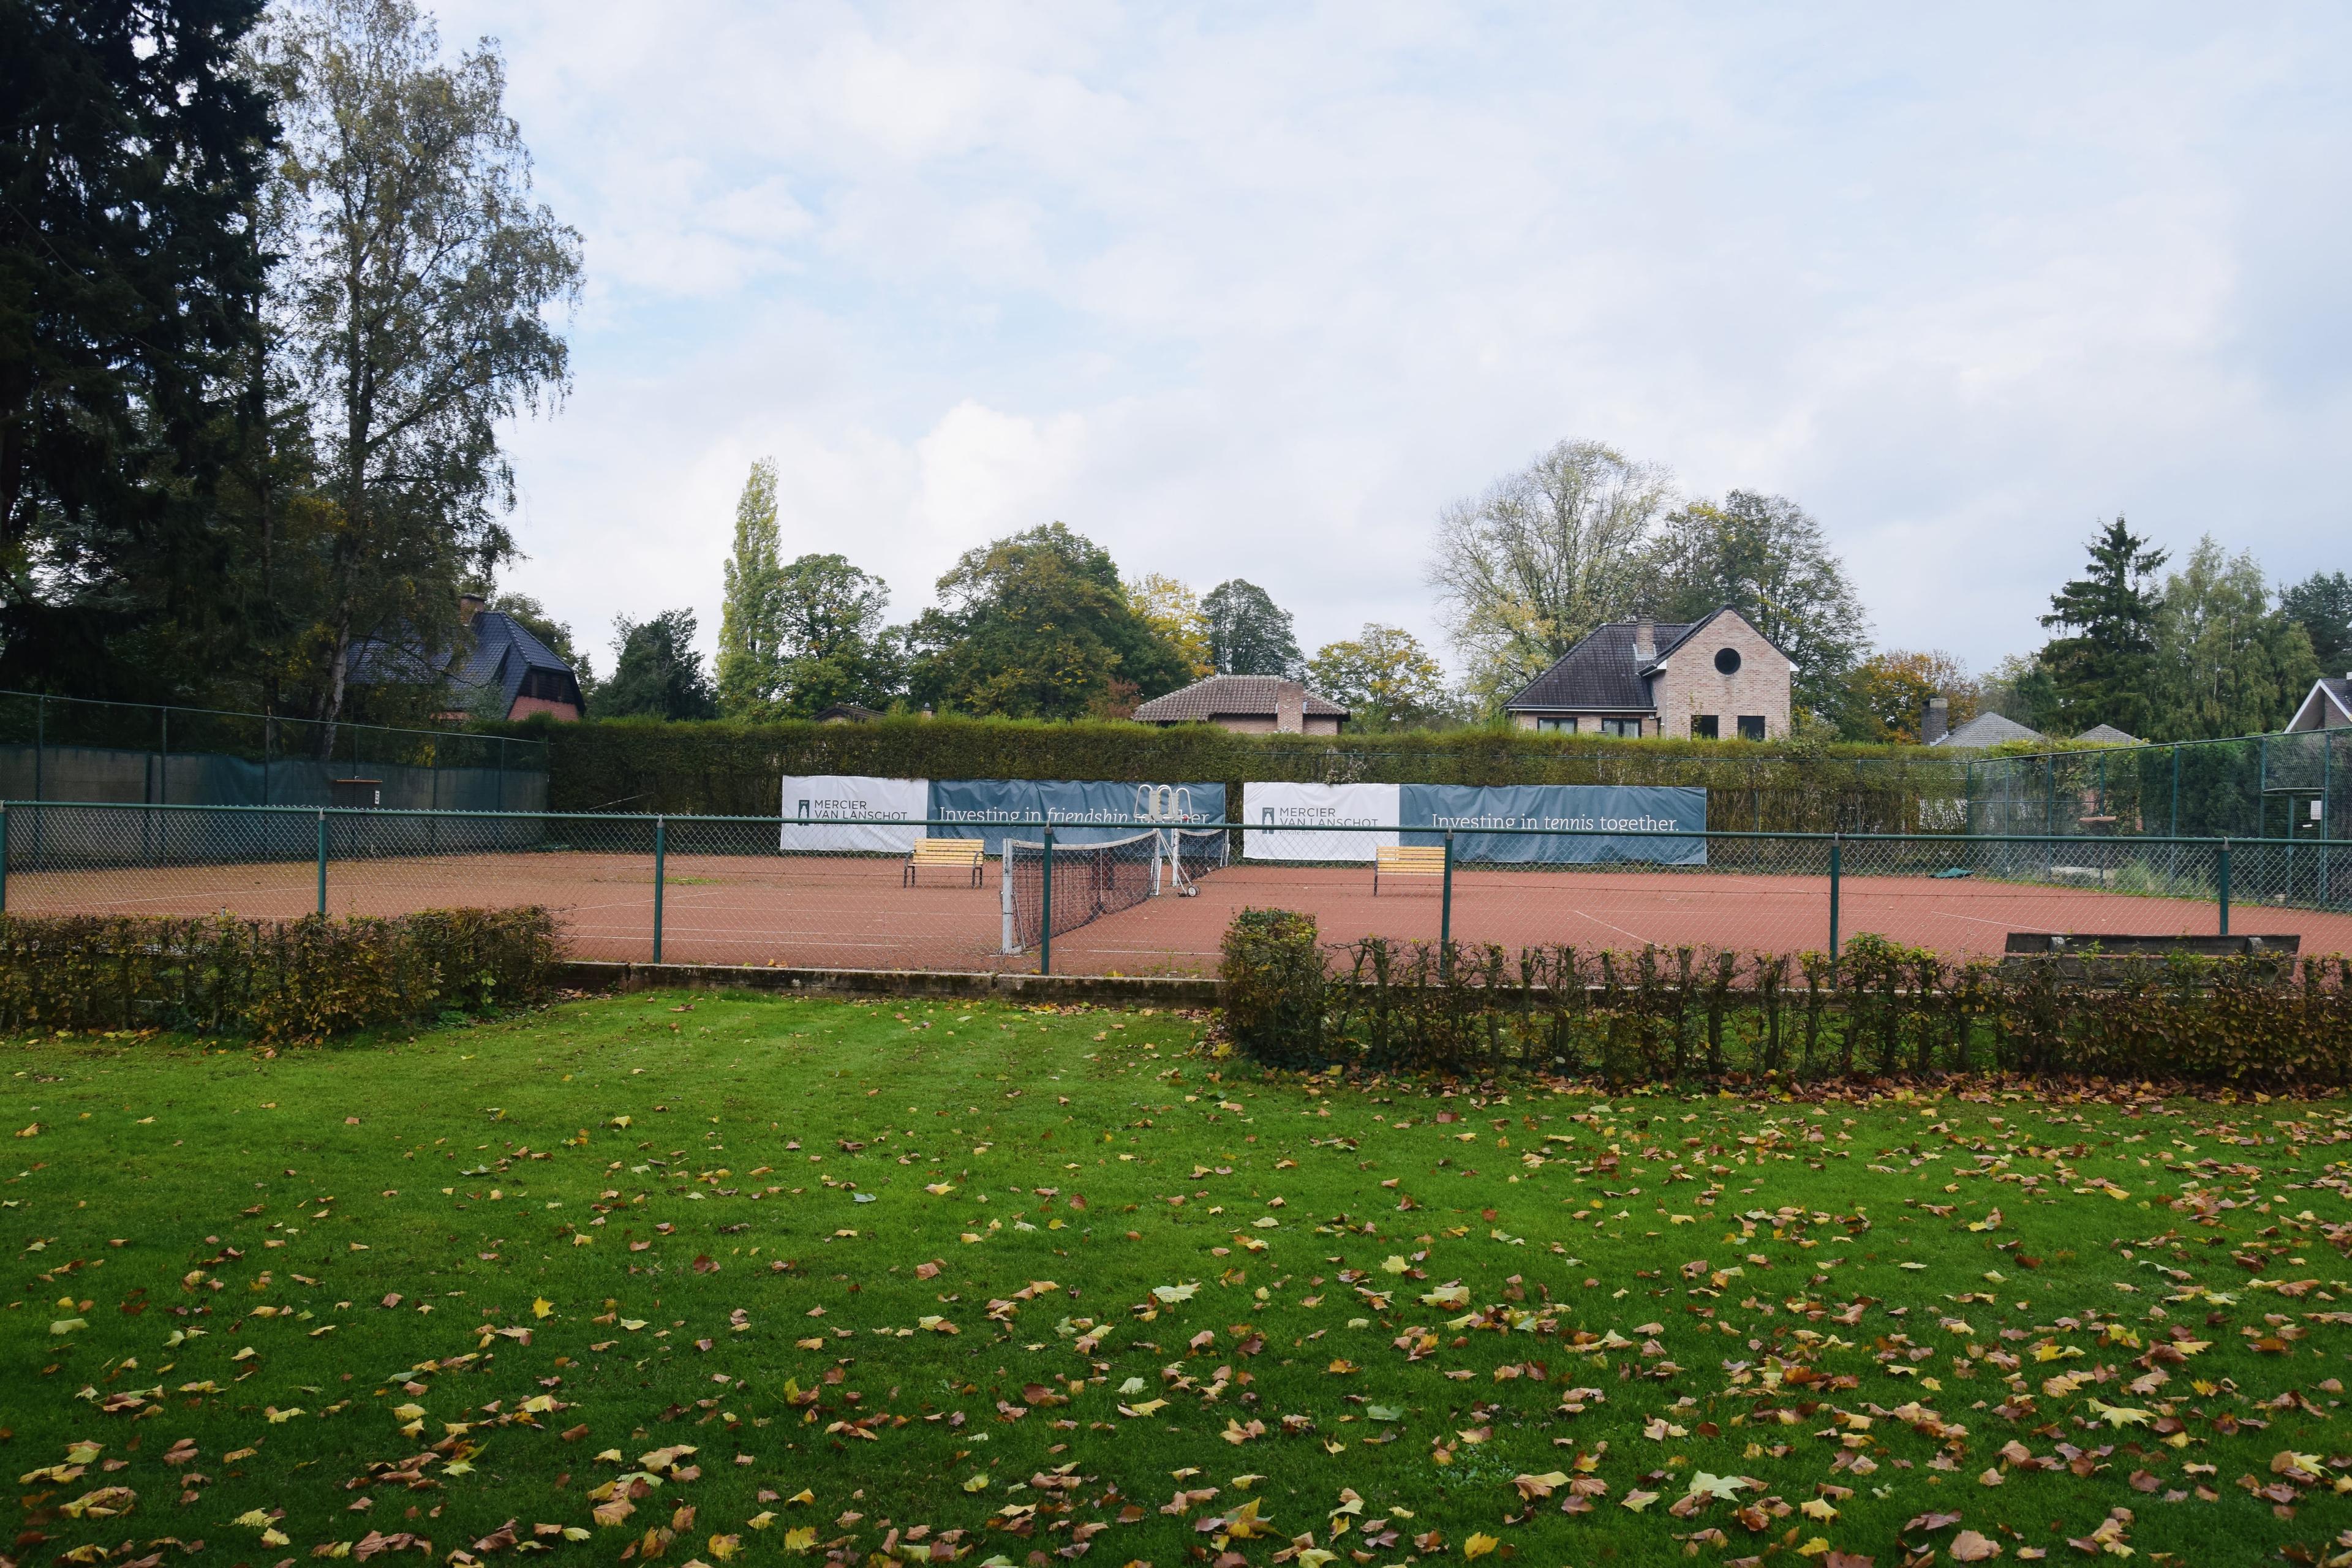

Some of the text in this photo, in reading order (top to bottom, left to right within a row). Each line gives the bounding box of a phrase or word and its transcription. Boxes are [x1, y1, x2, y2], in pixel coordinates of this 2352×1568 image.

[815, 800, 867, 809] MERCIER
[815, 810, 908, 820] VAN LANSCHOT
[940, 807, 1020, 821] Investing
[1025, 807, 1041, 821] in
[1280, 807, 1335, 817] MERCIER
[1432, 813, 1679, 831] Investing in tennis together.
